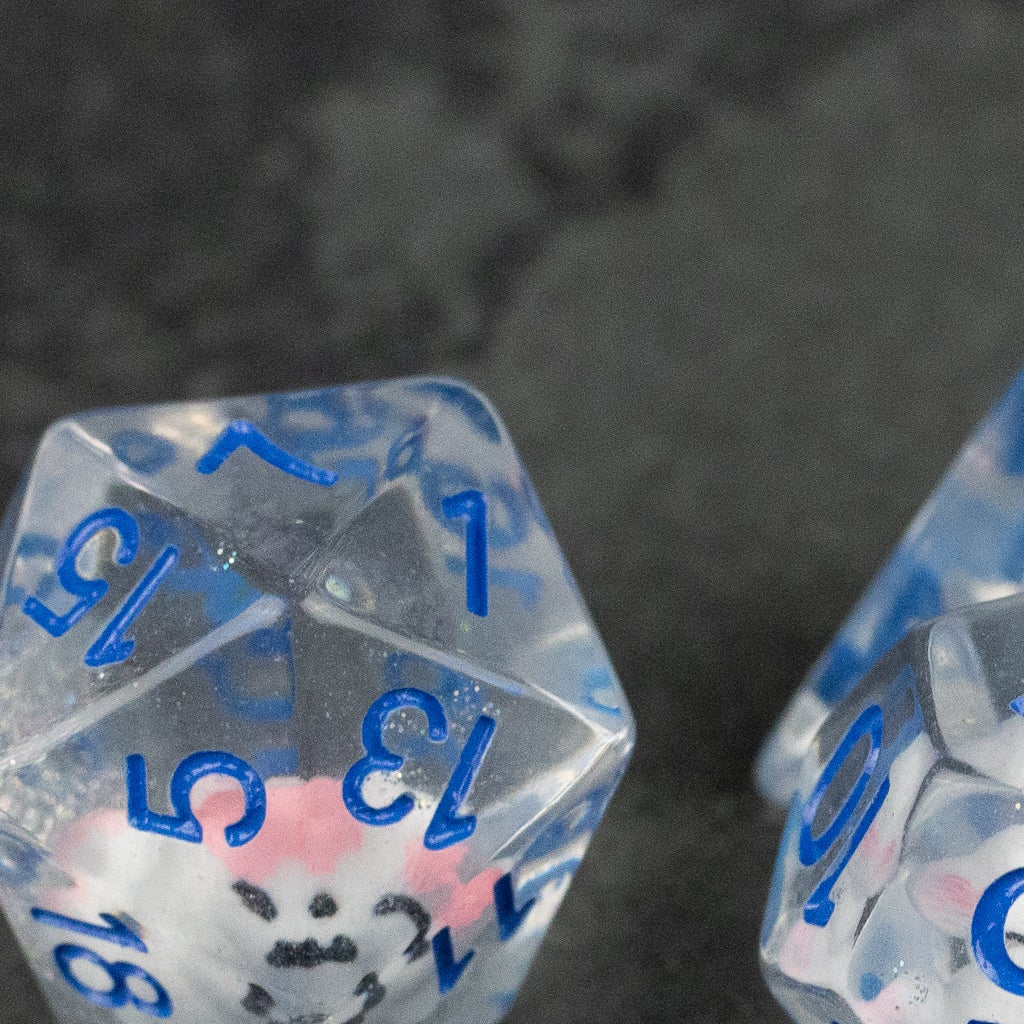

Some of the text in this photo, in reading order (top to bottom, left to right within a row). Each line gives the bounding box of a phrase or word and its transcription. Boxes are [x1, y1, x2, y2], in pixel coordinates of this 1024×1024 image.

[22, 507, 180, 667] 15
[441, 489, 488, 617] 1
[125, 750, 267, 848] 5
[342, 686, 496, 850] 13
[30, 906, 174, 1020] 18
